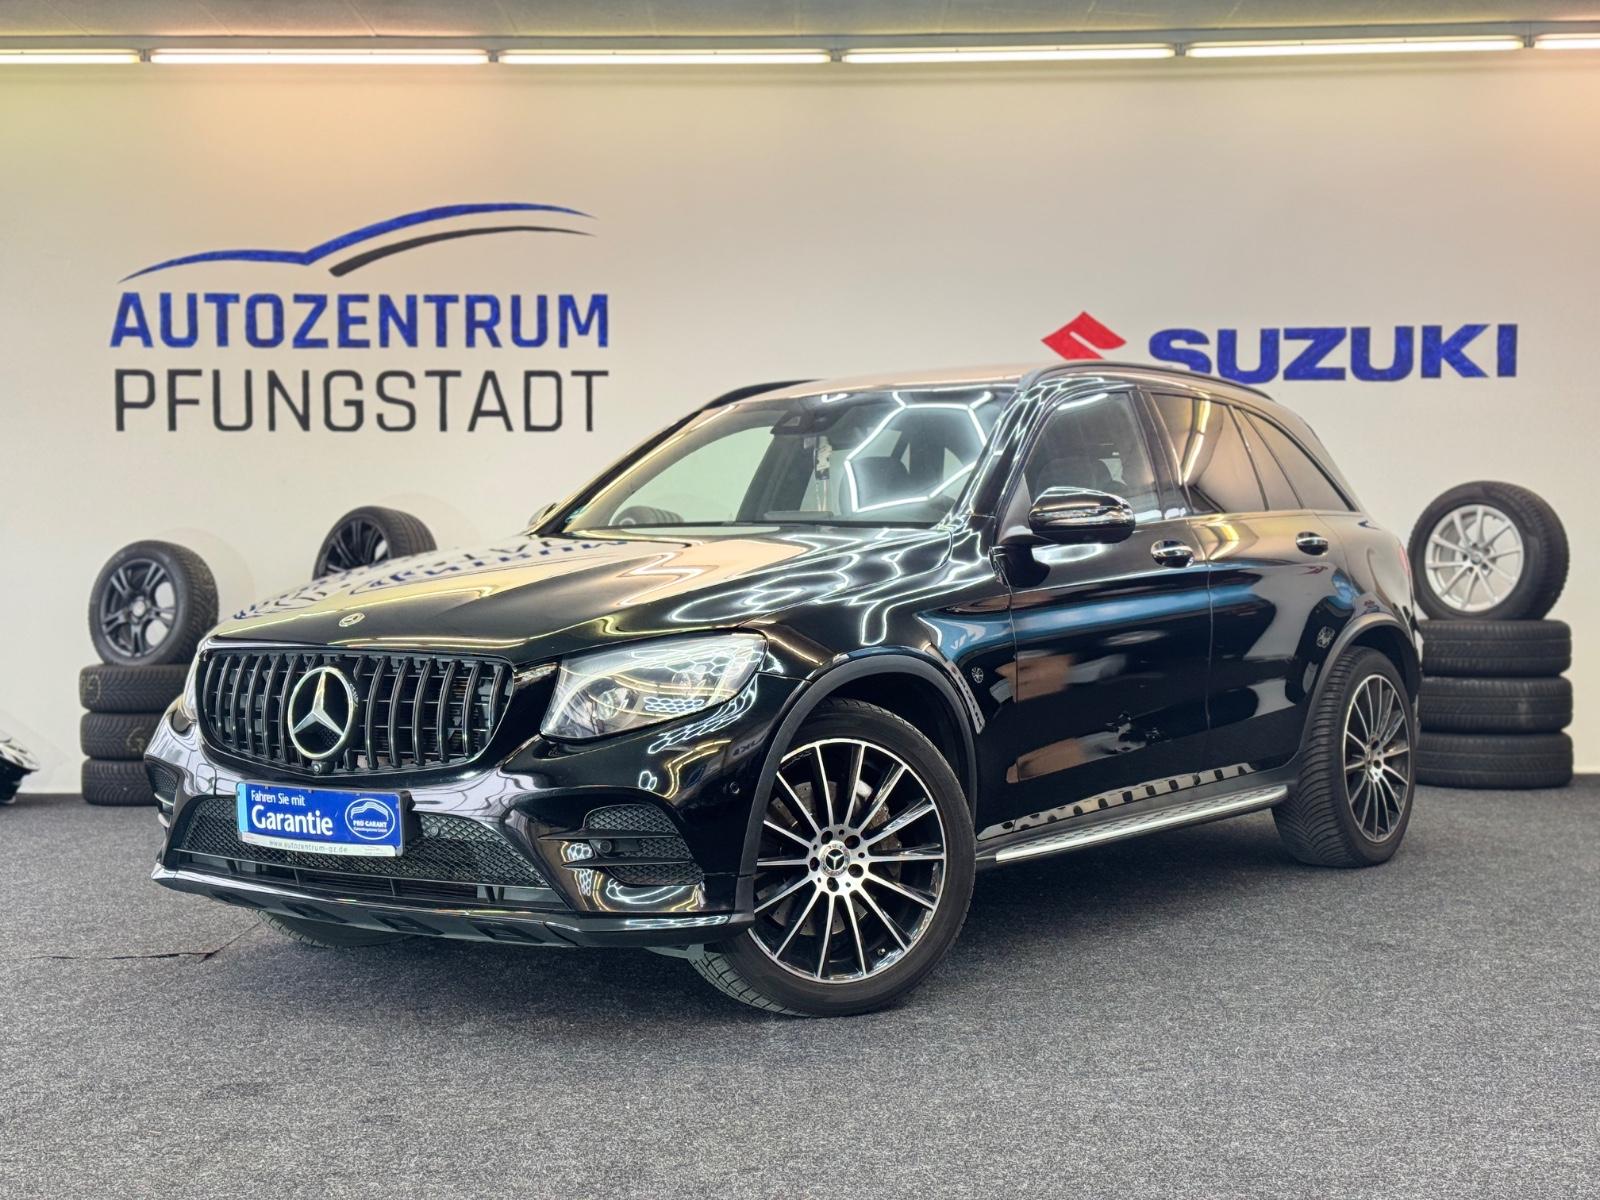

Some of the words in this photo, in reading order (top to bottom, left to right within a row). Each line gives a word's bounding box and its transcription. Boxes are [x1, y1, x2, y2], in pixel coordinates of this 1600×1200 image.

[110, 292, 609, 348] AUTOZENTRUM
[1148, 323, 1518, 384] SUZUKI
[115, 369, 610, 432] PFUNGSTADT
[251, 790, 276, 804] Fahren
[277, 792, 290, 805] Sie
[291, 794, 306, 806] mit
[251, 804, 334, 836] Garantie
